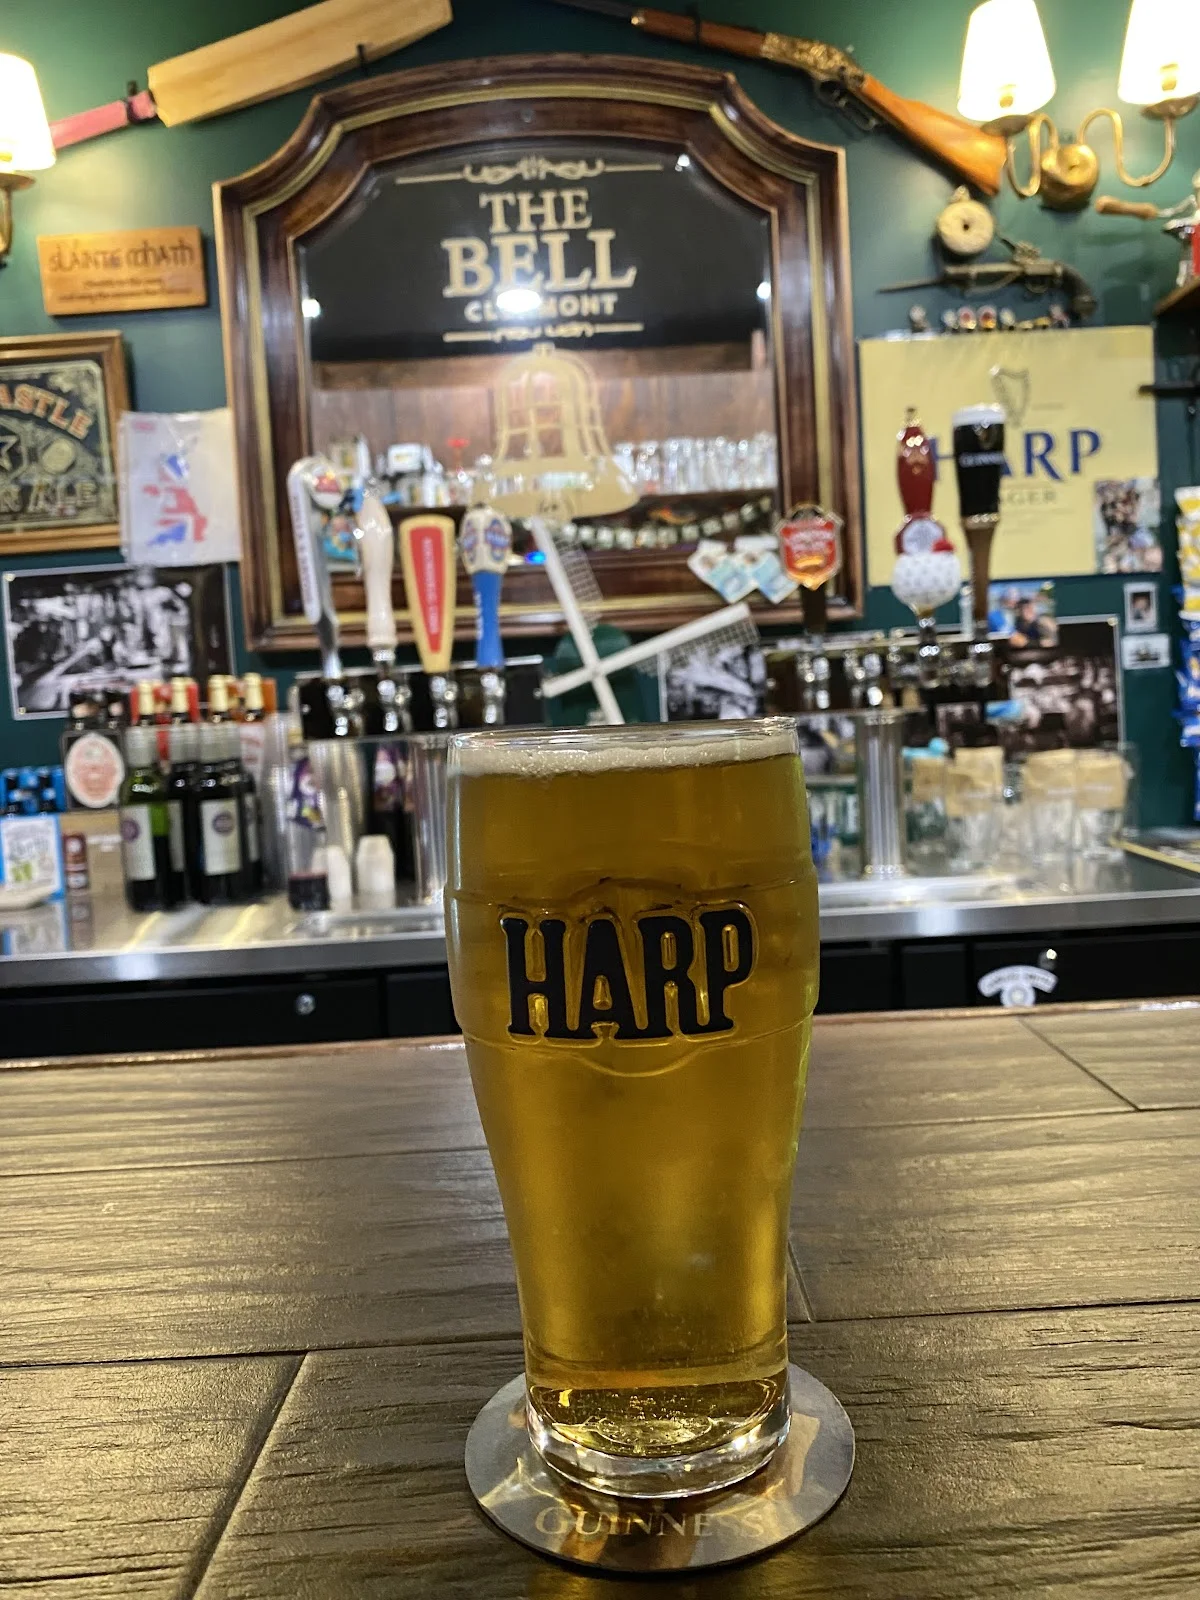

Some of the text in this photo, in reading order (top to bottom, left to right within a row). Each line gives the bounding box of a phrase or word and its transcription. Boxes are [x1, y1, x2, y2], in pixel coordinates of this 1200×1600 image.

[479, 188, 592, 234] THE
[440, 229, 637, 298] BELL
[464, 292, 618, 323] CLMONT
[499, 902, 757, 1043] HARP
[534, 1505, 766, 1538] GUINNESS
